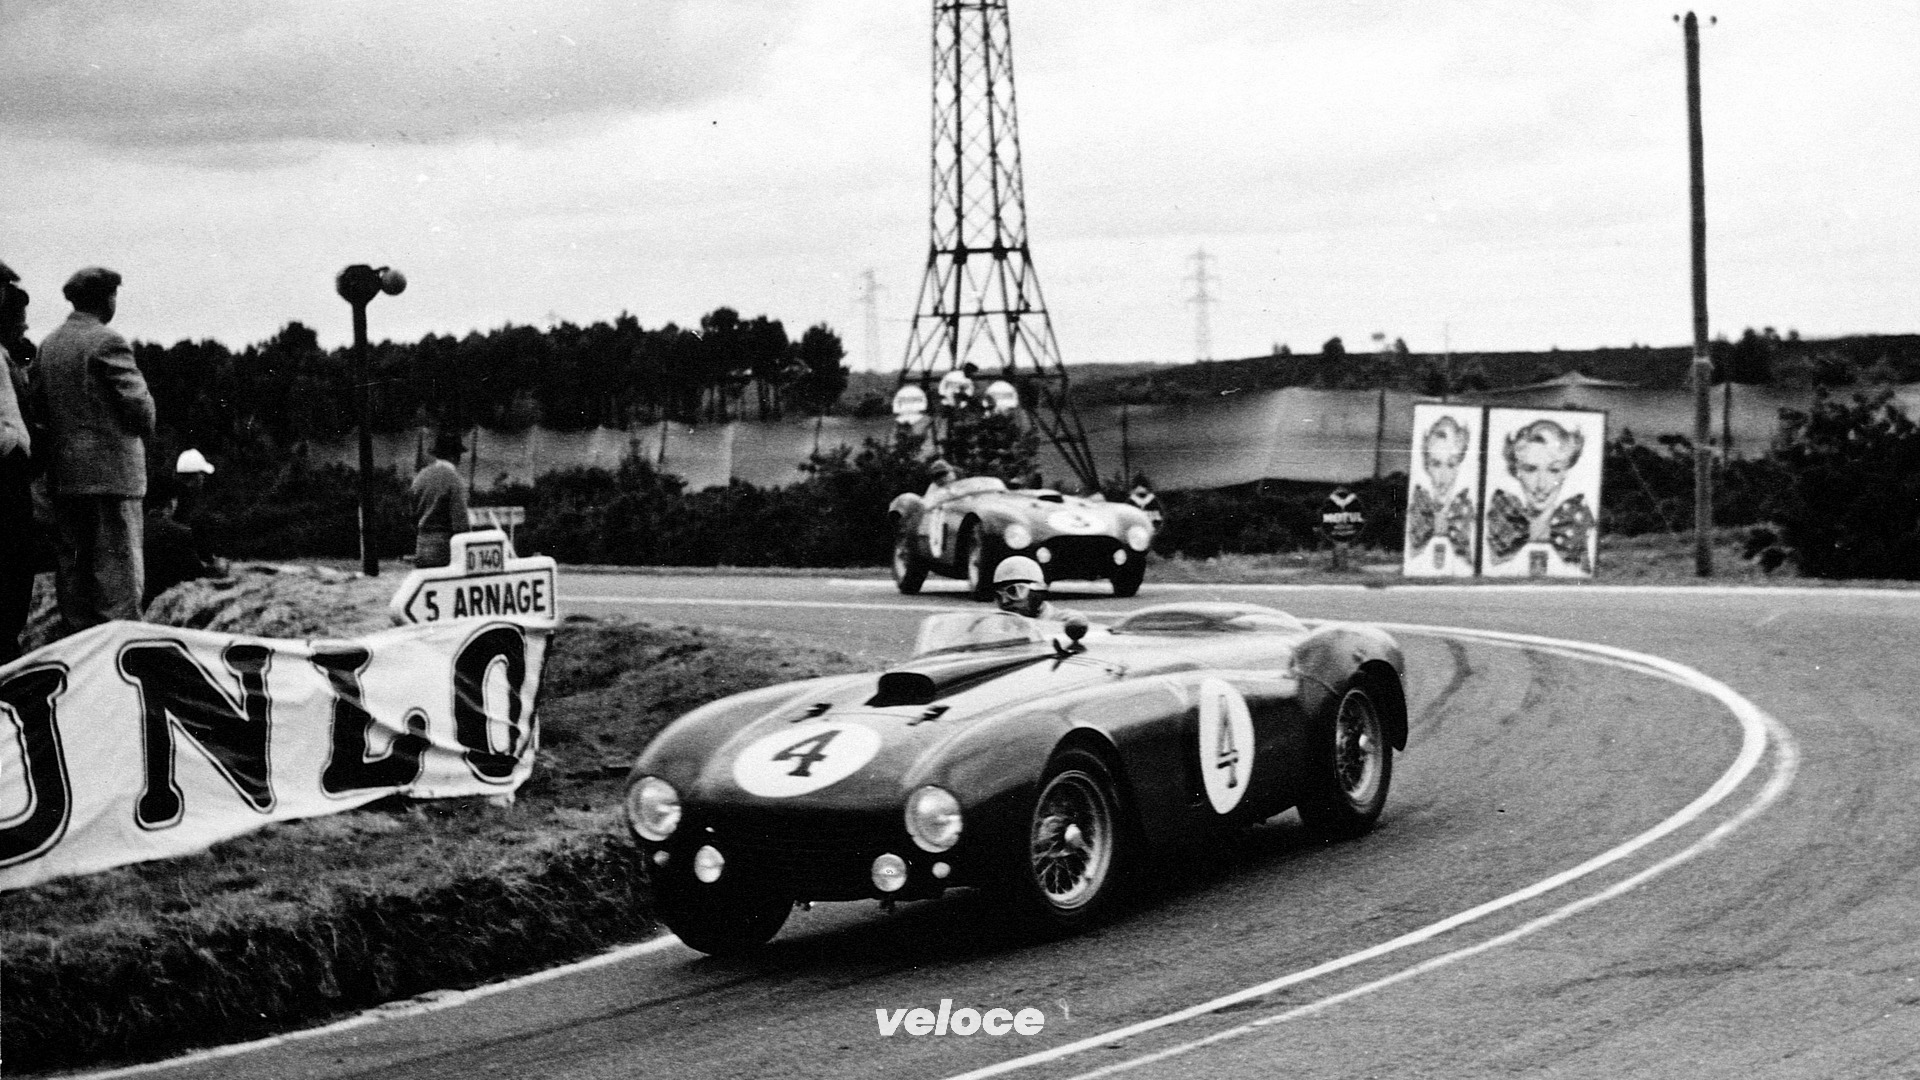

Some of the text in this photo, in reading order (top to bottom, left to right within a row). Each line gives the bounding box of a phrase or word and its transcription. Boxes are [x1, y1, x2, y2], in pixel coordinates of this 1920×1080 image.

[479, 549, 501, 568] 140
[425, 579, 546, 622] 5 ARNAGE
[771, 729, 842, 777] 4
[1217, 694, 1238, 788] 4
